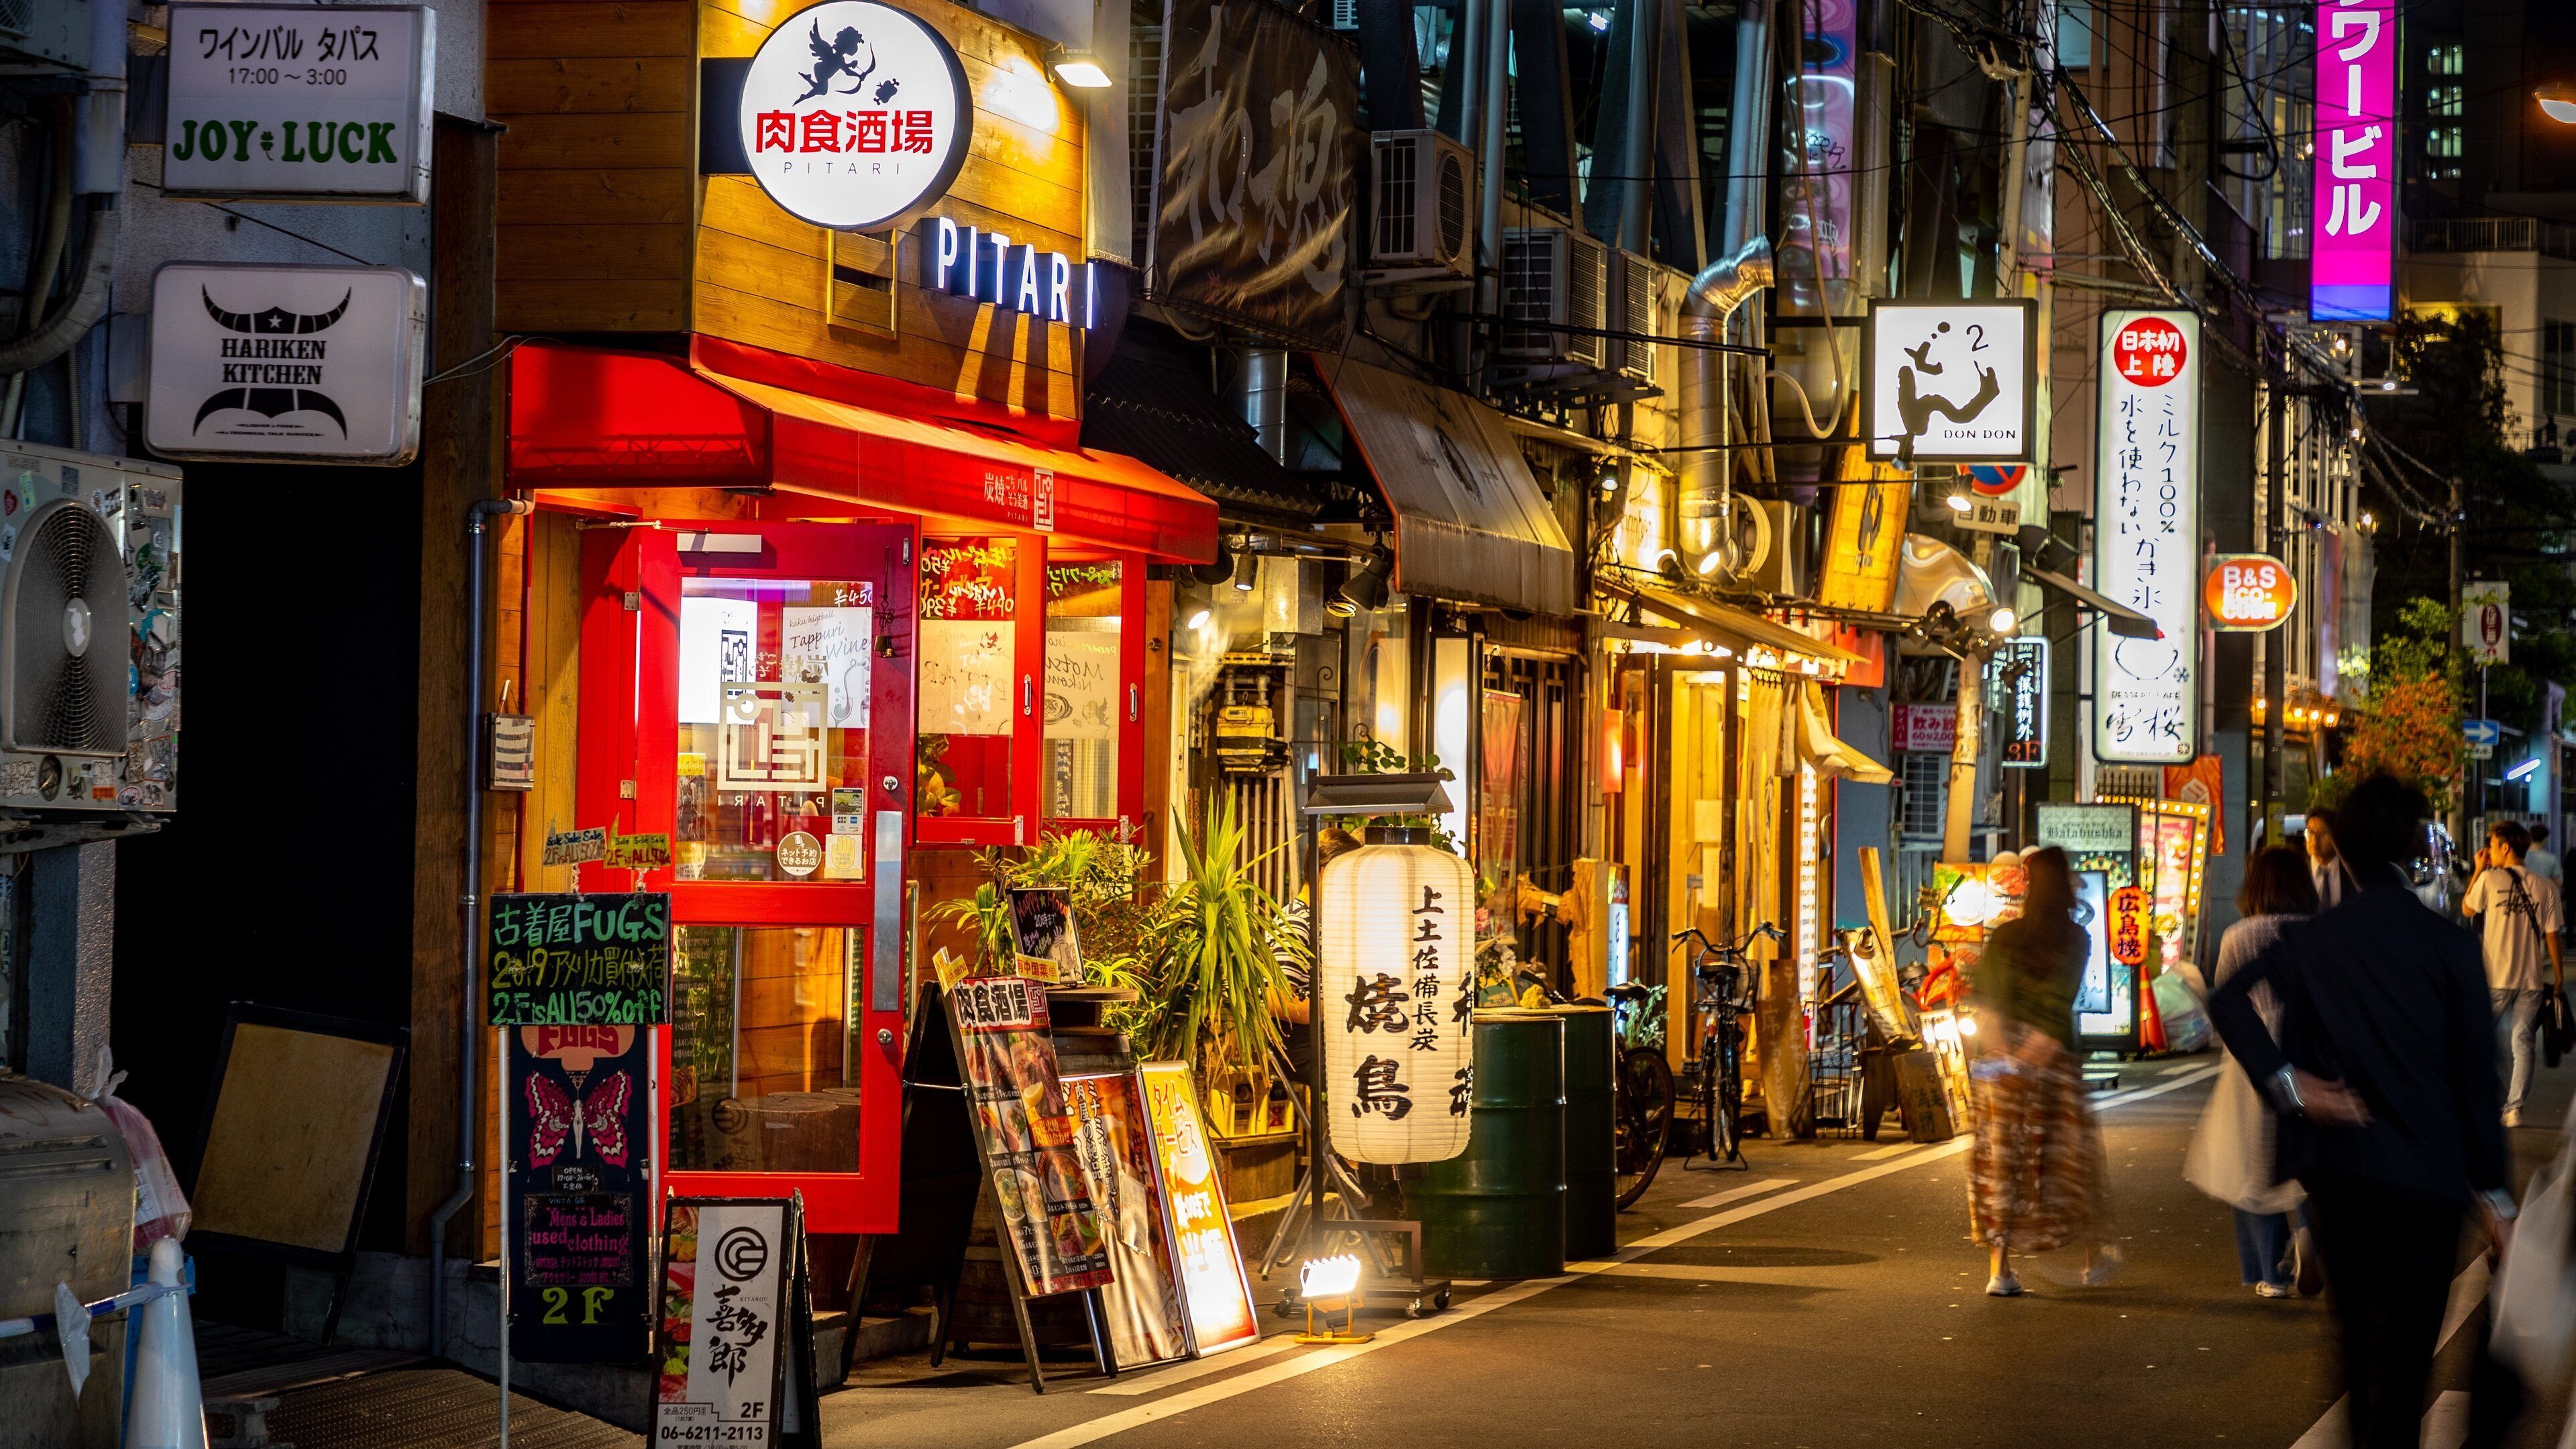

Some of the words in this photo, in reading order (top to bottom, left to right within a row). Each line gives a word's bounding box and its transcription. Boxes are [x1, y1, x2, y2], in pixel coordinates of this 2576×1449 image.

[200, 25, 303, 60] ワインバル
[317, 25, 378, 62] タパス
[2325, 0, 2382, 237] ワービル
[173, 119, 258, 161] JOY
[280, 121, 397, 164] LUCK
[755, 109, 932, 154] 肉食酒場
[784, 162, 900, 174] PITARI
[938, 216, 1094, 329] PITARI
[221, 338, 327, 360] HARIKEN
[2122, 329, 2180, 353] 日本初
[222, 363, 323, 384] KITCHEN
[2123, 352, 2176, 377] 上陸
[1944, 429, 1976, 439] DON
[1984, 429, 2015, 439] DON
[984, 472, 1005, 506] 炭焼
[790, 621, 845, 651] Tappuri
[826, 638, 871, 660] Wine
[782, 848, 817, 857] ネット予約
[782, 857, 817, 866] できるお店
[1409, 885, 1444, 1051] 上土佐備長炭
[1346, 973, 1413, 1121] 焼鳥
[1153, 1079, 1185, 1118] タイム
[1155, 1120, 1198, 1158] サービス
[590, 1207, 625, 1227] Ladies
[532, 1227, 568, 1246] used
[567, 1233, 629, 1256] clothing
[706, 1284, 768, 1389] 喜多郎
[741, 1402, 764, 1419] 2F
[661, 1426, 763, 1441] 06-6211-2113
